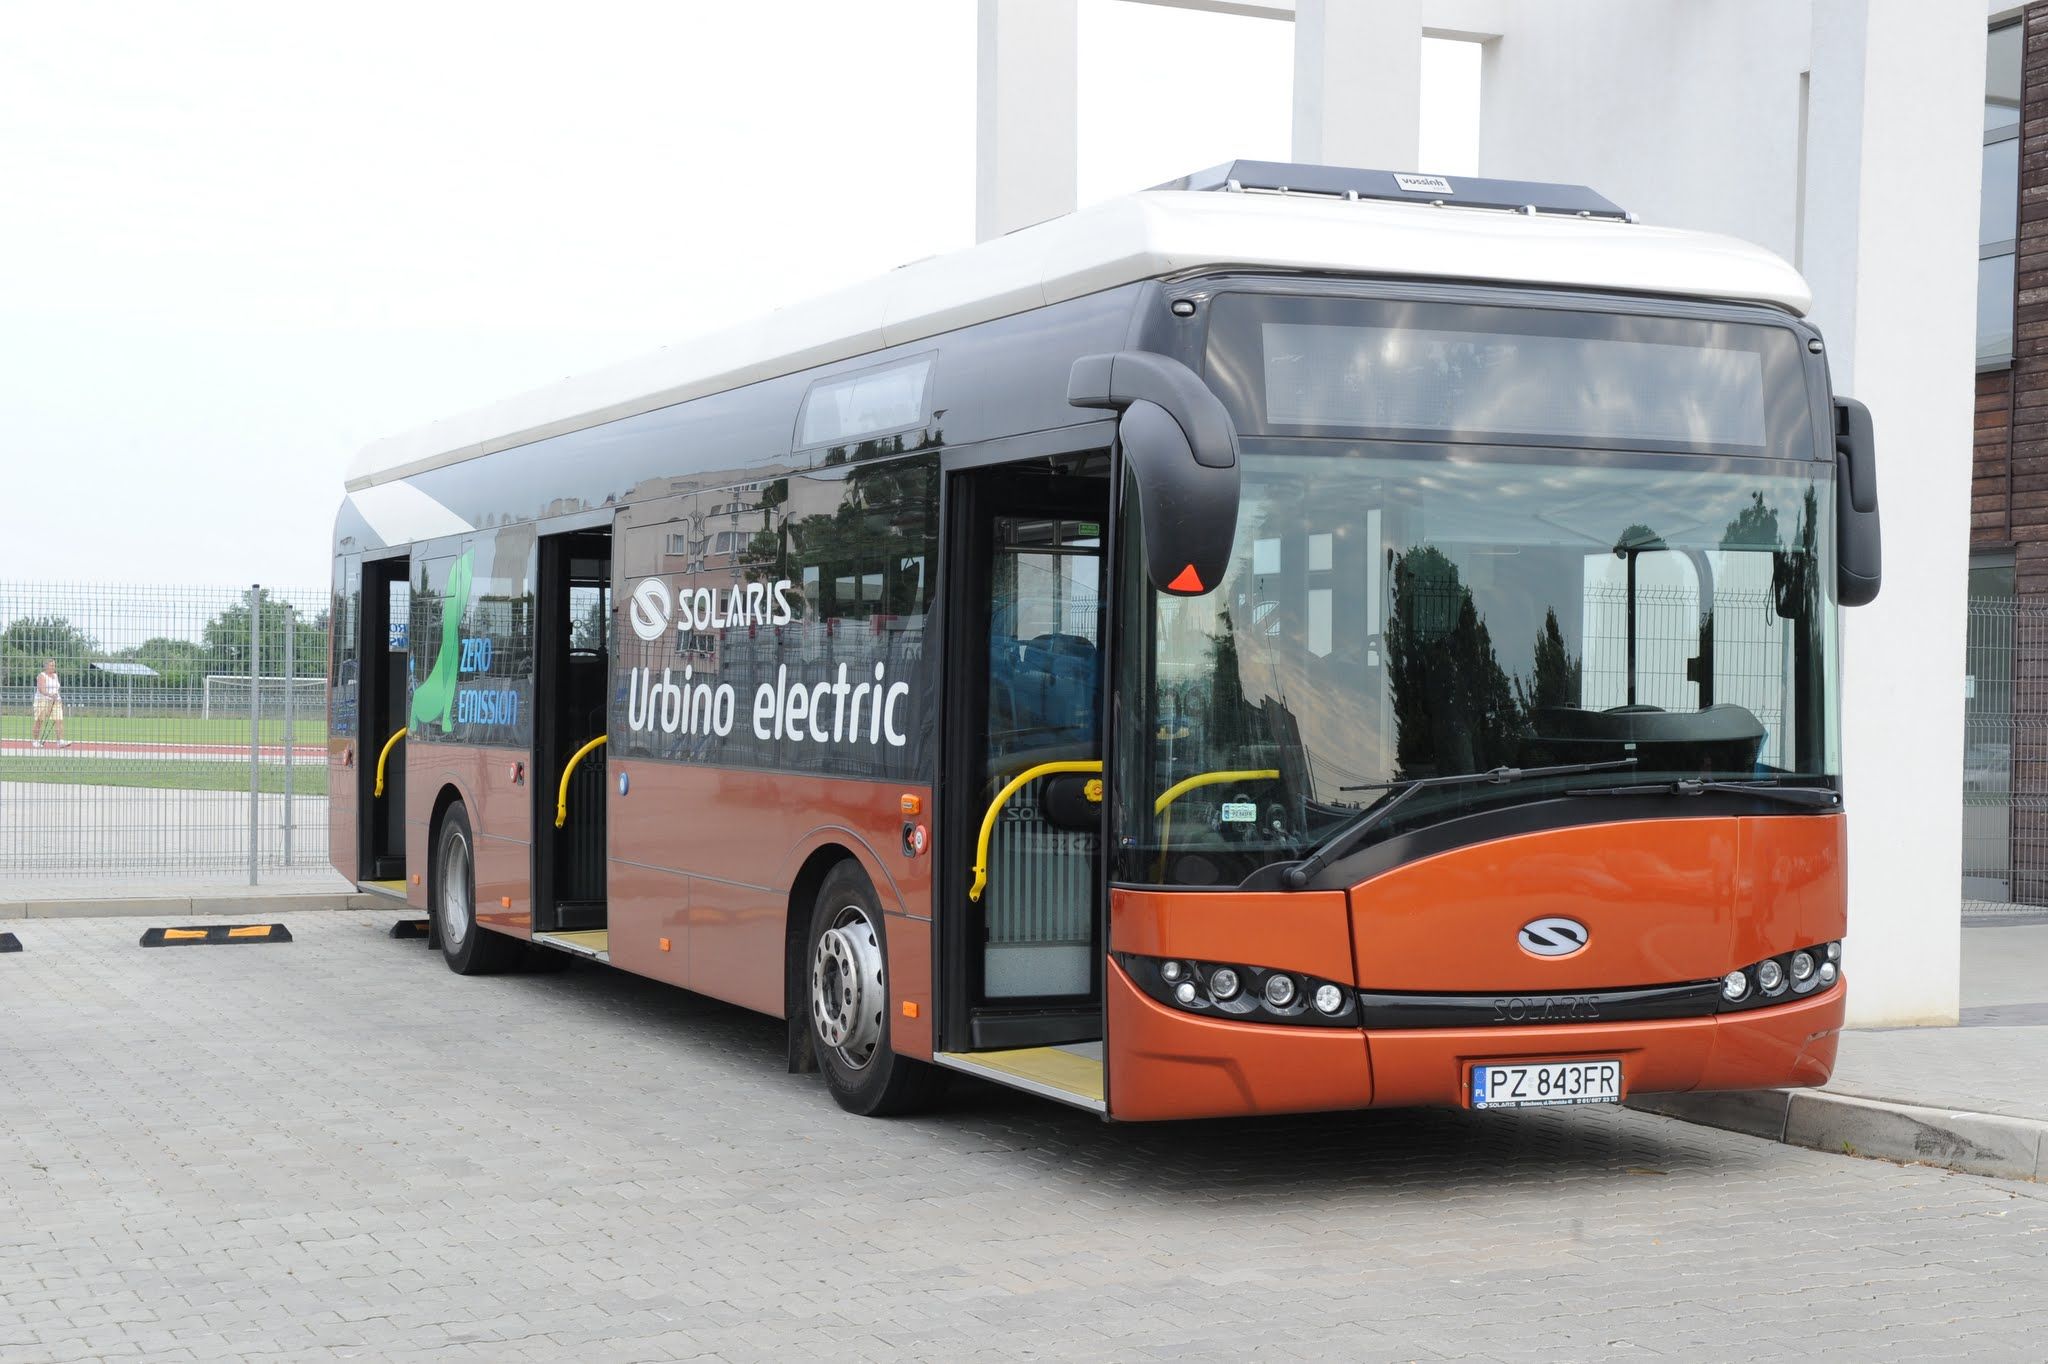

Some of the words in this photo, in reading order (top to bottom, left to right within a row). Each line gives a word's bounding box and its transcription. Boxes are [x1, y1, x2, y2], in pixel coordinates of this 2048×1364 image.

[678, 580, 792, 631] SOLARIS
[460, 637, 493, 673] ZERO
[628, 664, 735, 737] Urbino
[753, 661, 909, 746] electric
[1494, 996, 1600, 1021] SOLARIS
[1475, 1089, 1485, 1097] PL
[1491, 1069, 1527, 1098] PZ
[1537, 1066, 1614, 1096] 843FR
